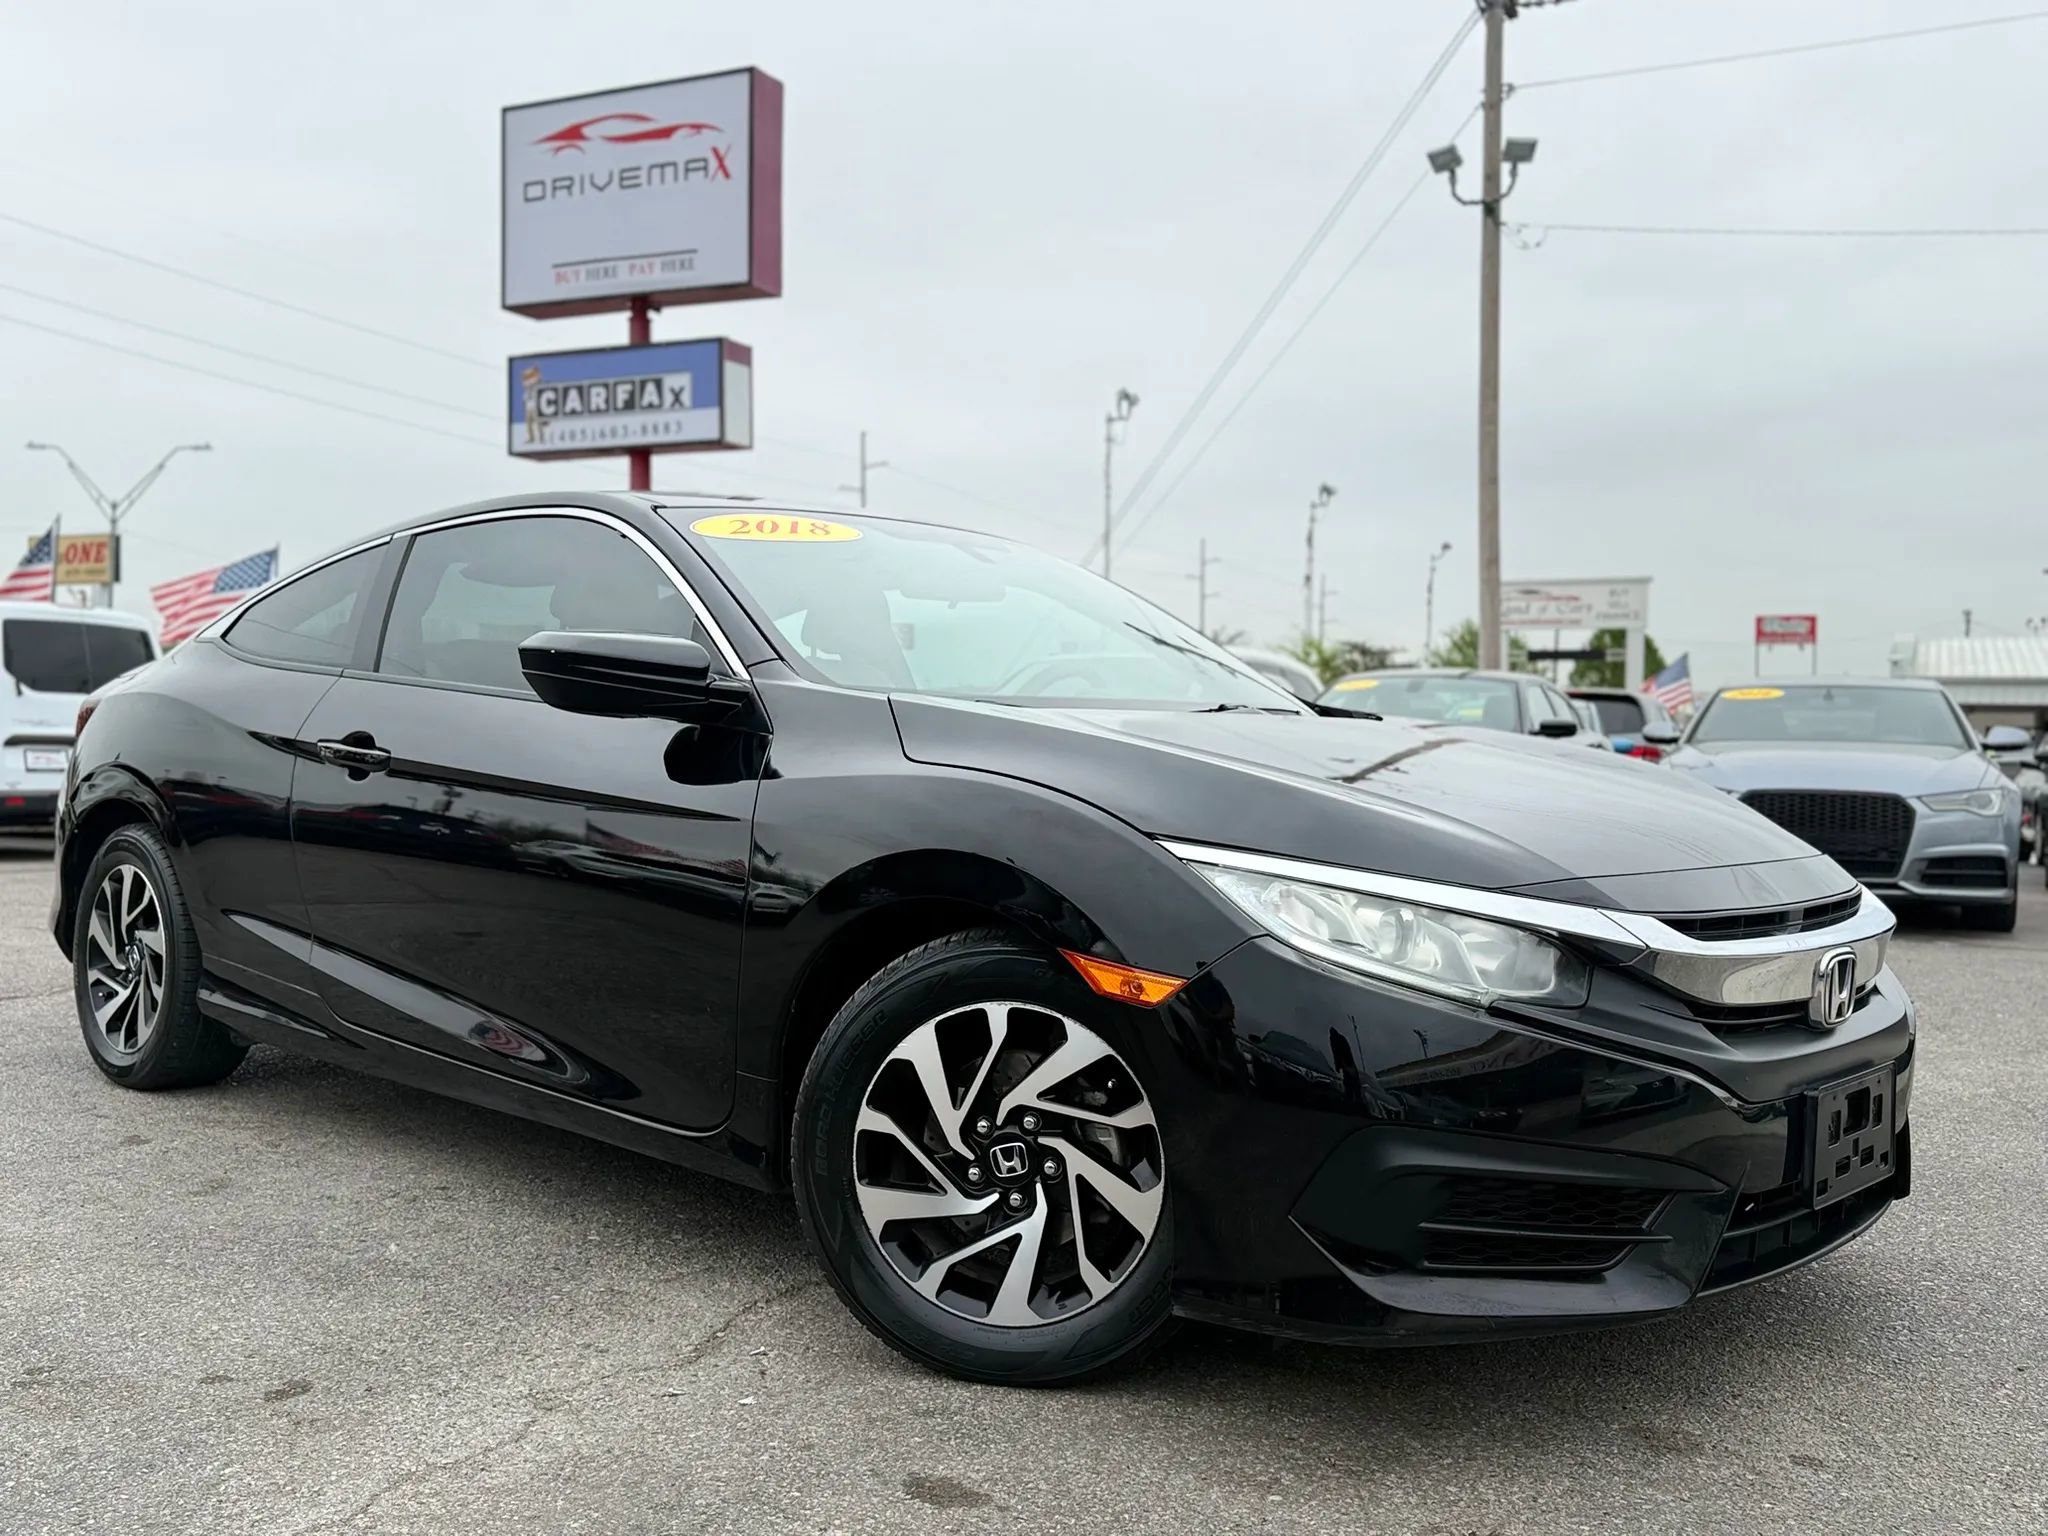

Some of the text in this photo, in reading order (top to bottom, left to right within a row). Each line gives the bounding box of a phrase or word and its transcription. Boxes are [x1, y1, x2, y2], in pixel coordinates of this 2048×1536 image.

[522, 144, 732, 203] DRIVEMAX
[537, 376, 687, 416] CARFAX
[728, 518, 832, 536] 2018
[64, 540, 108, 565] ONE
